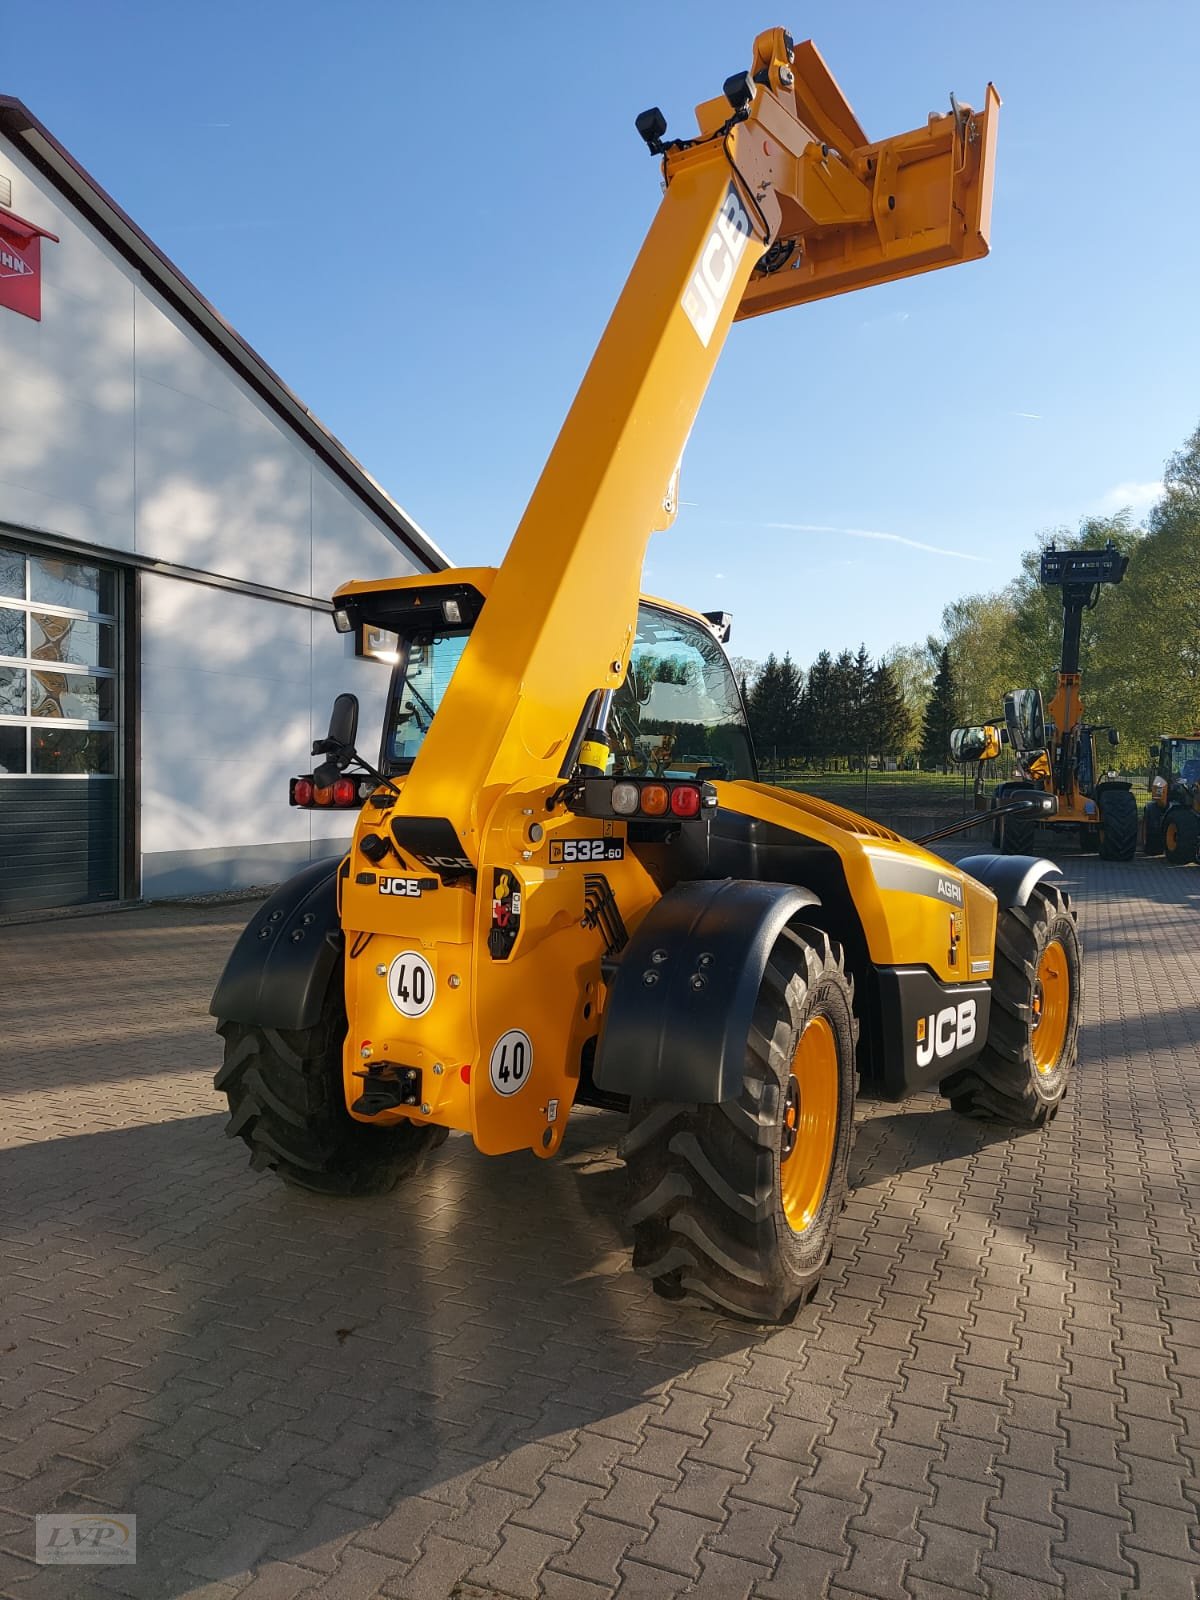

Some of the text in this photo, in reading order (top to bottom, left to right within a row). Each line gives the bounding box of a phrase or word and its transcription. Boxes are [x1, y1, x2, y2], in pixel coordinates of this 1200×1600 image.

[0, 250, 25, 274] HN
[691, 193, 749, 338] JCB
[380, 877, 421, 897] JCB
[937, 878, 962, 902] AGRI
[397, 964, 426, 1005] 40
[916, 999, 977, 1068] JCB
[498, 1041, 525, 1083] 40
